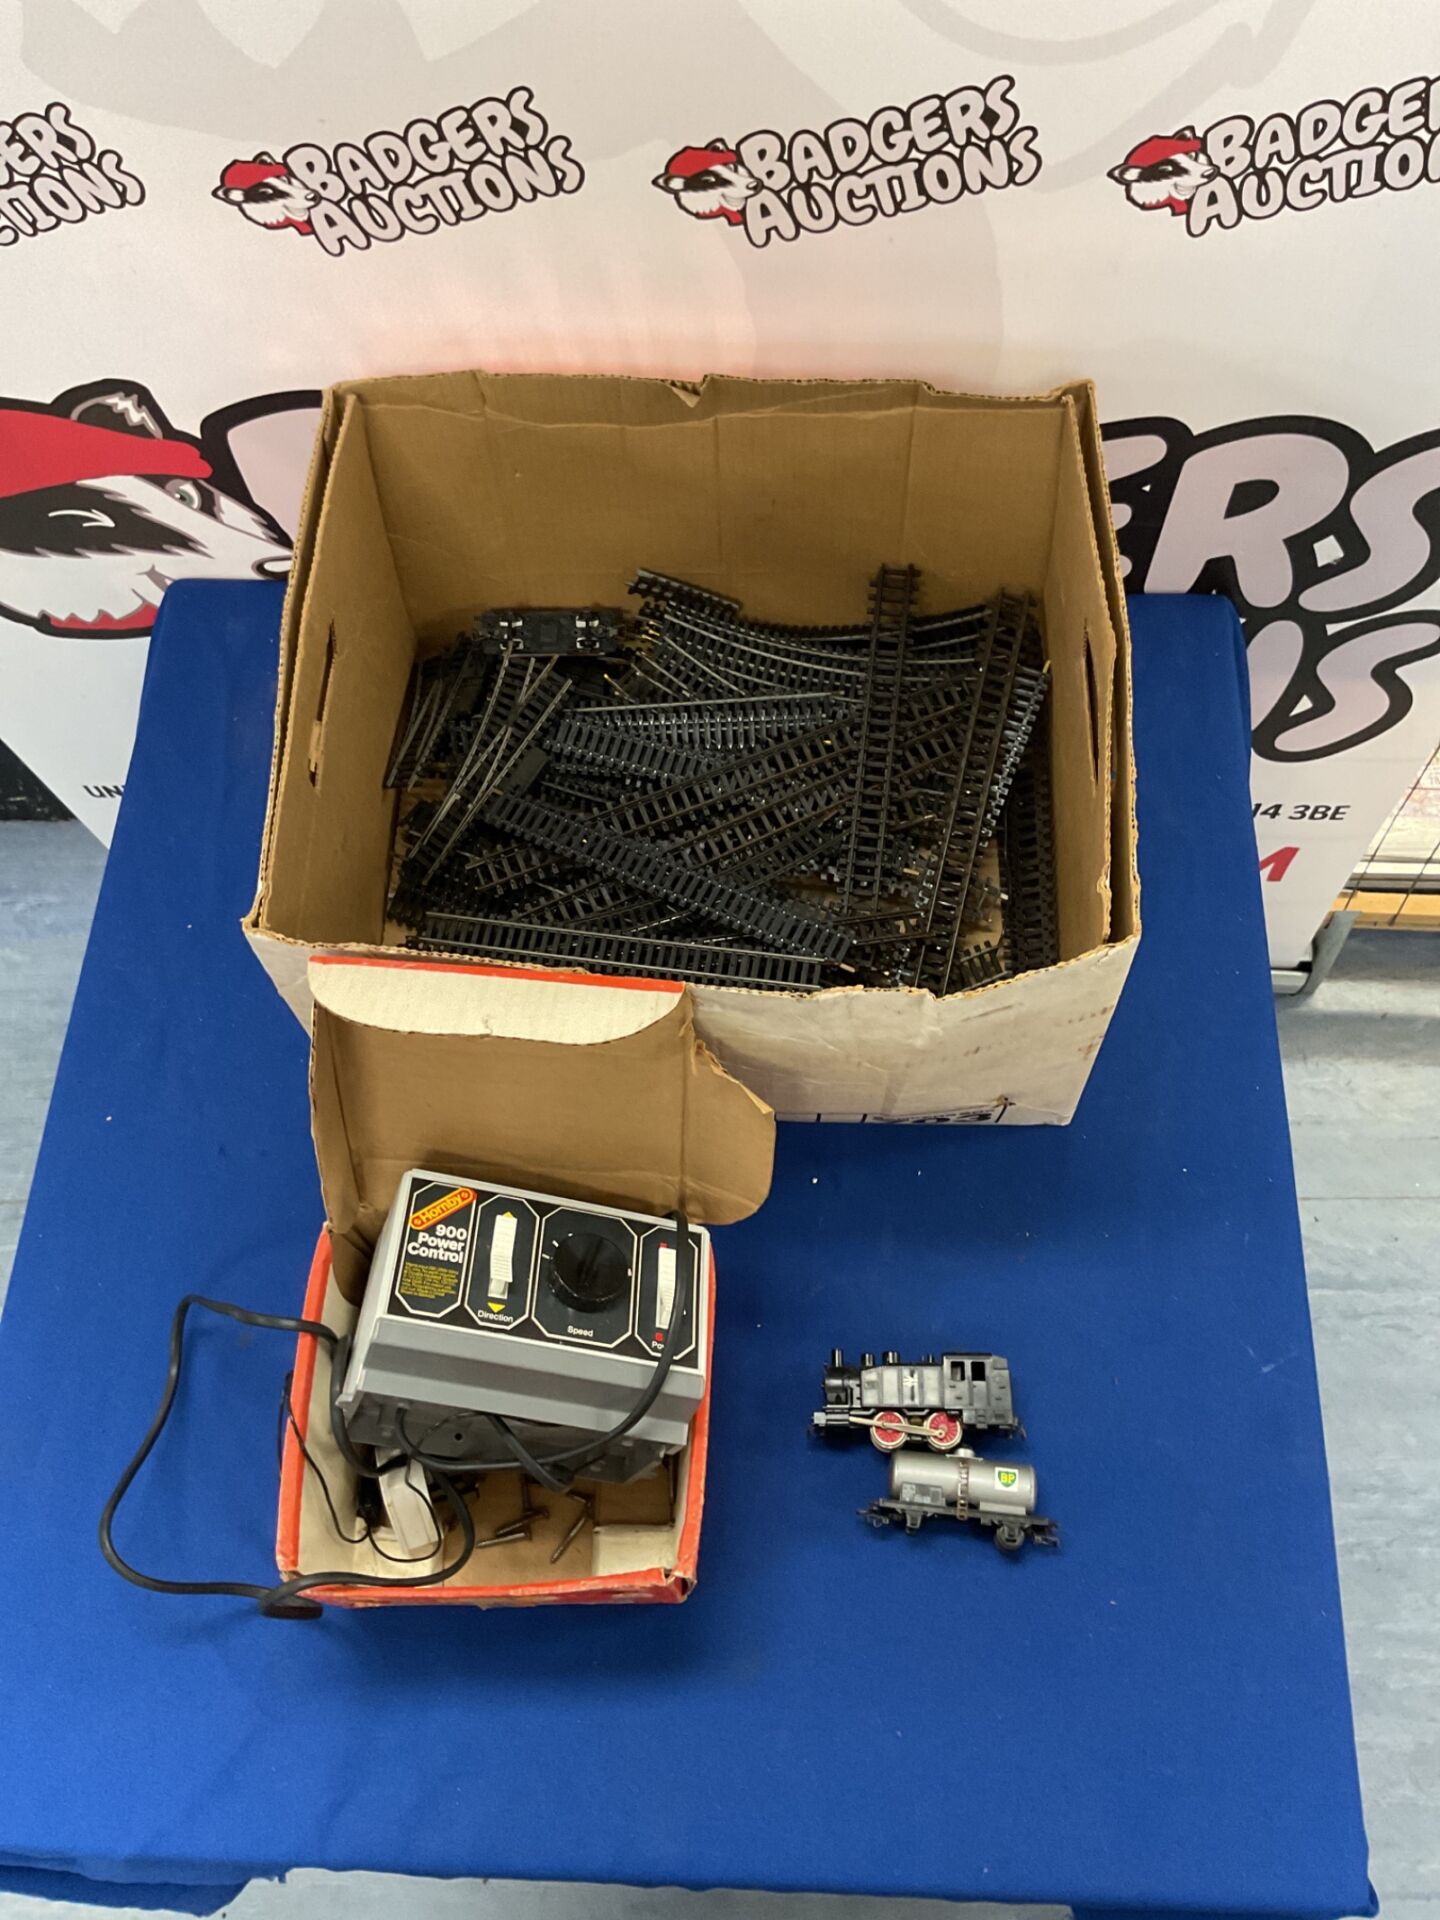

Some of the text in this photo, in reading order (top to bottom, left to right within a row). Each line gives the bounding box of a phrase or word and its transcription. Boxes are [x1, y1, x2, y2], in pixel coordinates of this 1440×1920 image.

[0, 101, 97, 186] ERS
[735, 74, 1020, 192] BADGERS
[282, 85, 548, 203] BADGERS
[309, 134, 585, 257] AUCTIONS
[743, 125, 1042, 248] AUCTIONS
[1288, 804, 1351, 821] 3BE
[419, 1193, 464, 1222] Hornby
[417, 1232, 465, 1252] Power
[435, 1224, 467, 1240] 900
[407, 1242, 464, 1263] Control
[477, 1310, 514, 1322] Direction
[567, 1325, 594, 1337] Speed
[1000, 1472, 1015, 1484] BP
